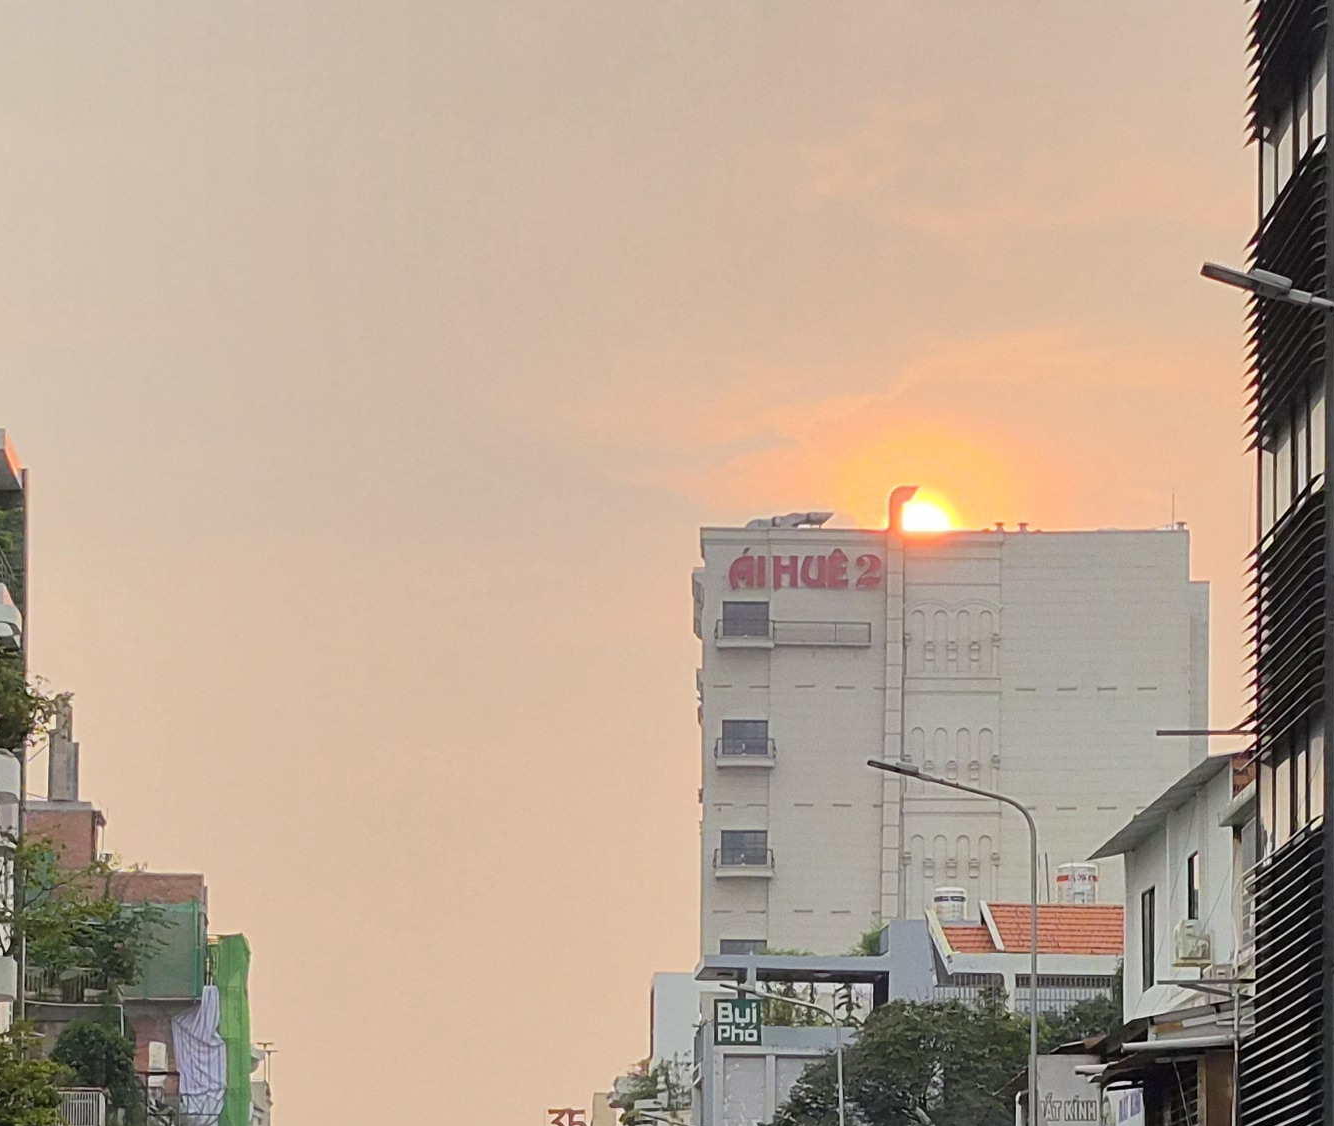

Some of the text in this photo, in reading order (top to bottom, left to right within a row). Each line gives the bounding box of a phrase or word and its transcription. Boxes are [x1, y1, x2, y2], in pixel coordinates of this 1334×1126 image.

[729, 547, 766, 591] ÁI
[855, 554, 882, 590] 2
[717, 1002, 757, 1027] Bụi
[1064, 1095, 1097, 1121] KÍNH
